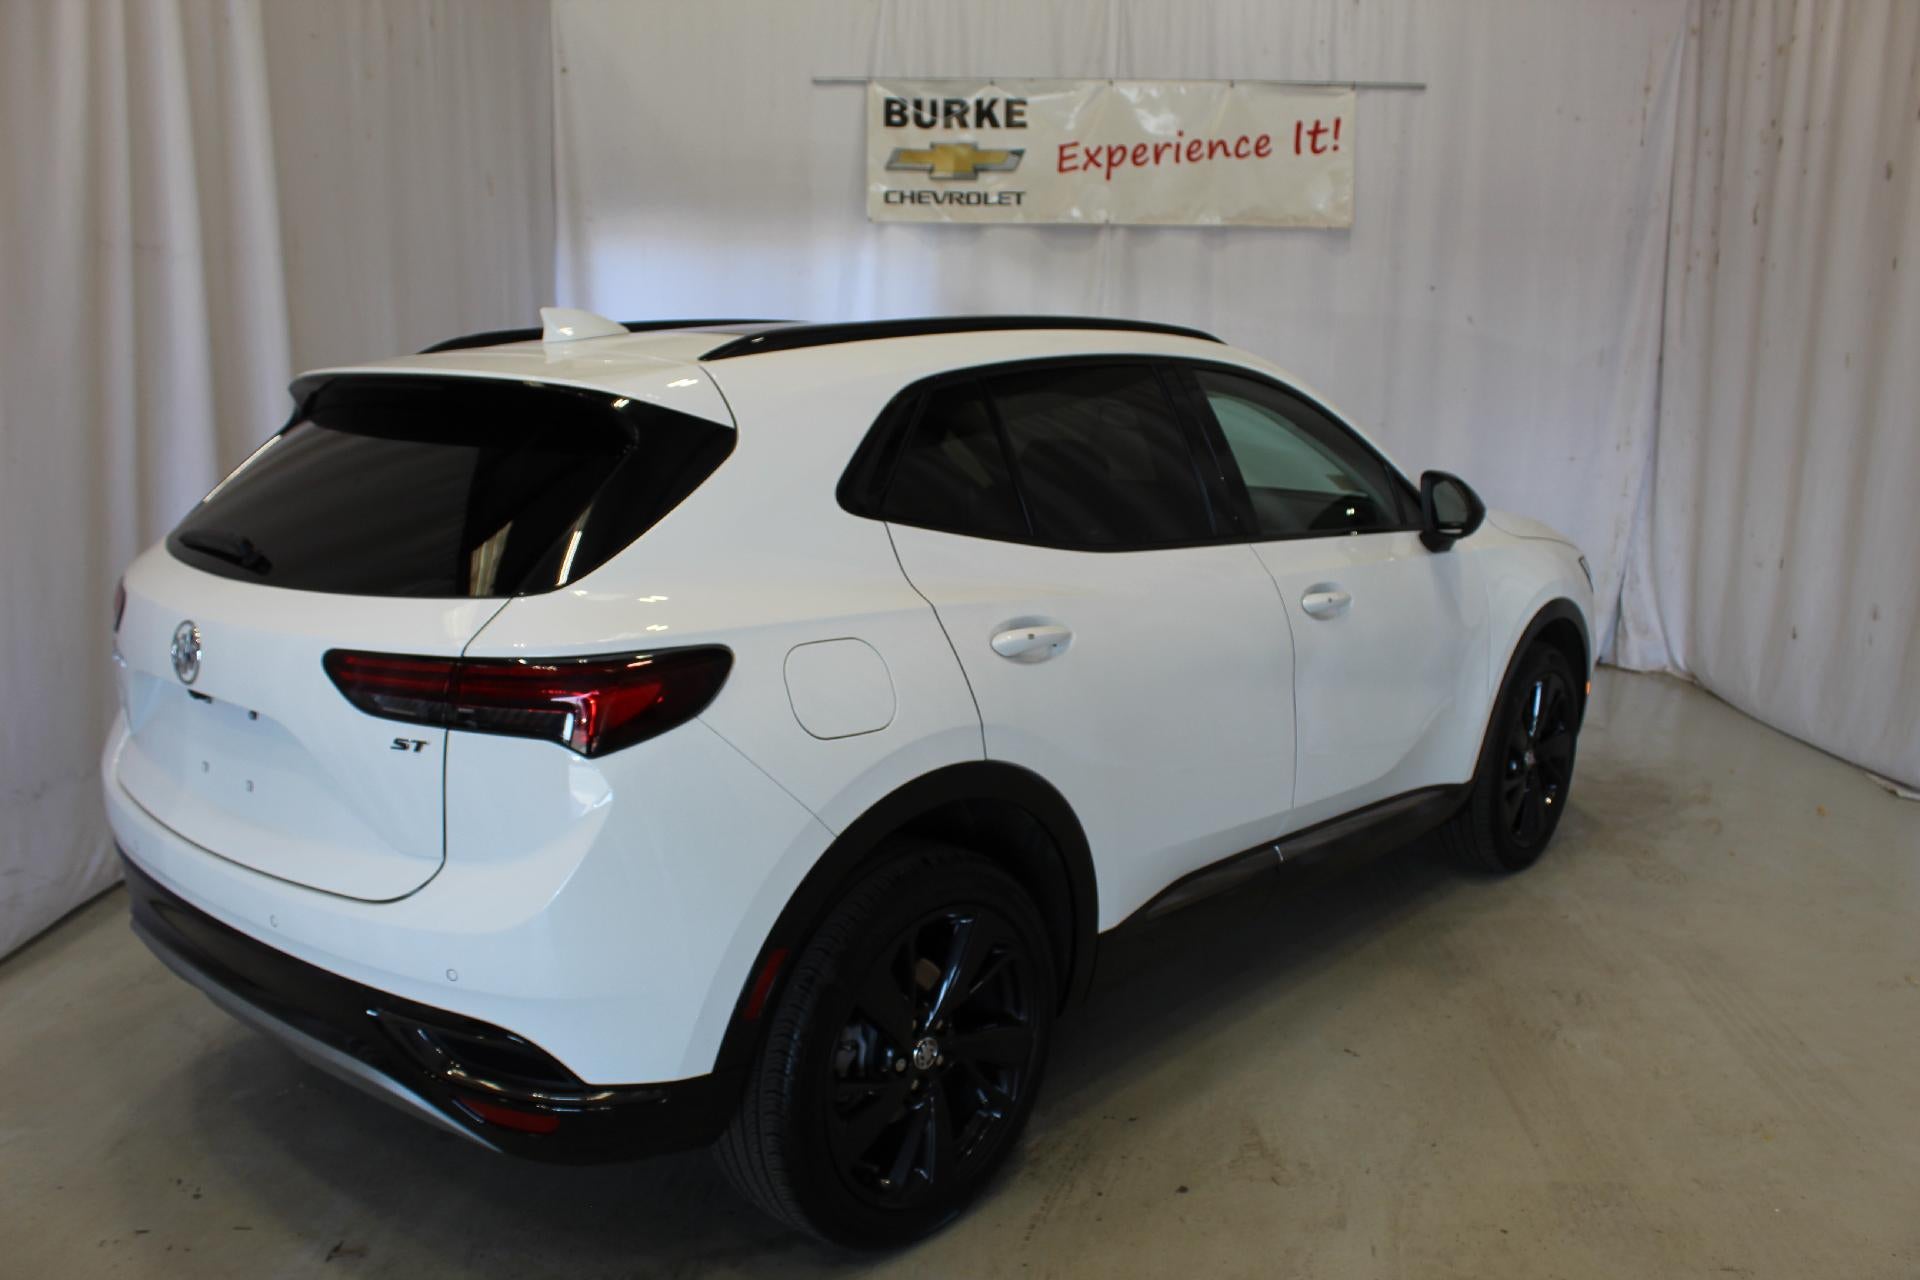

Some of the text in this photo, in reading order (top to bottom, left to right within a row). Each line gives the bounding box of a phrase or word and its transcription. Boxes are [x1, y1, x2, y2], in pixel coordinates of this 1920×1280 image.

[884, 97, 1028, 129] BURKE
[1056, 118, 1342, 180] Experience It!
[883, 190, 1026, 206] CHEVROLET
[390, 738, 429, 753] ST
